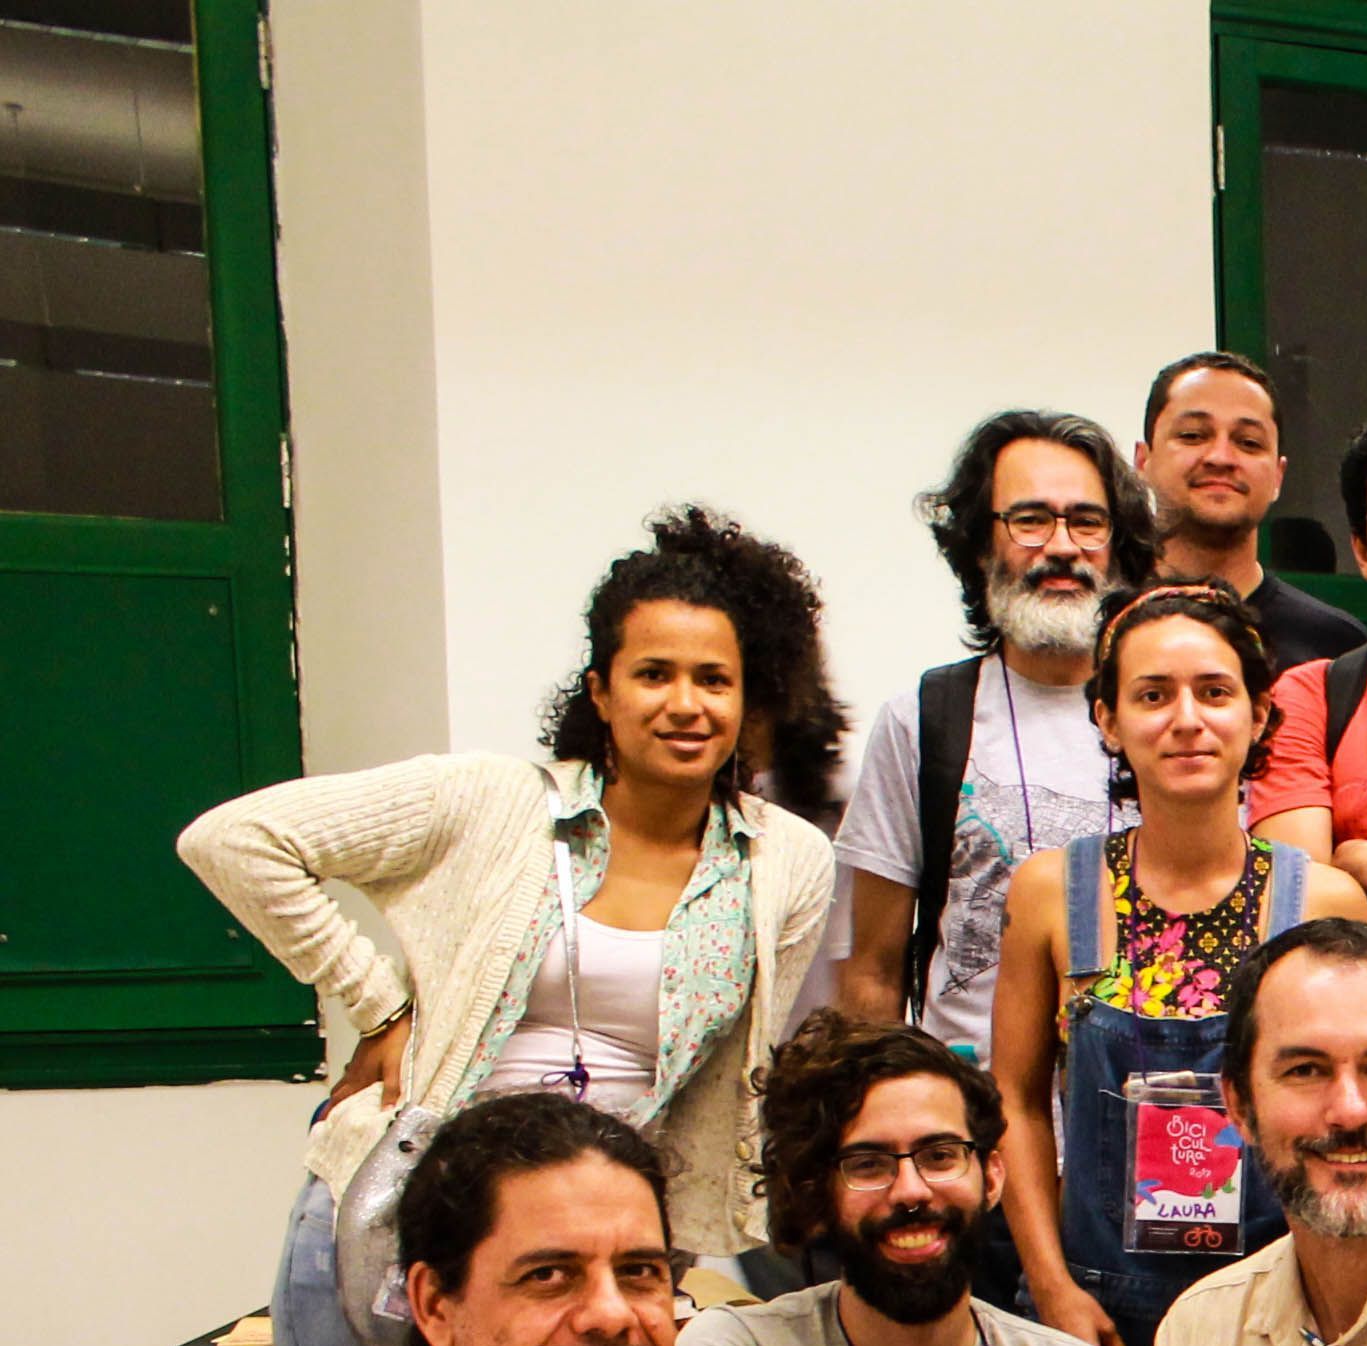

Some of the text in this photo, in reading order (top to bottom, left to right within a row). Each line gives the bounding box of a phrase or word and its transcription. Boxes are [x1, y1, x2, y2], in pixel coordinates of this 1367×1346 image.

[1166, 1115, 1206, 1138] BICI
[1179, 1136, 1211, 1152] CUL
[1157, 1203, 1216, 1219] LAURA
